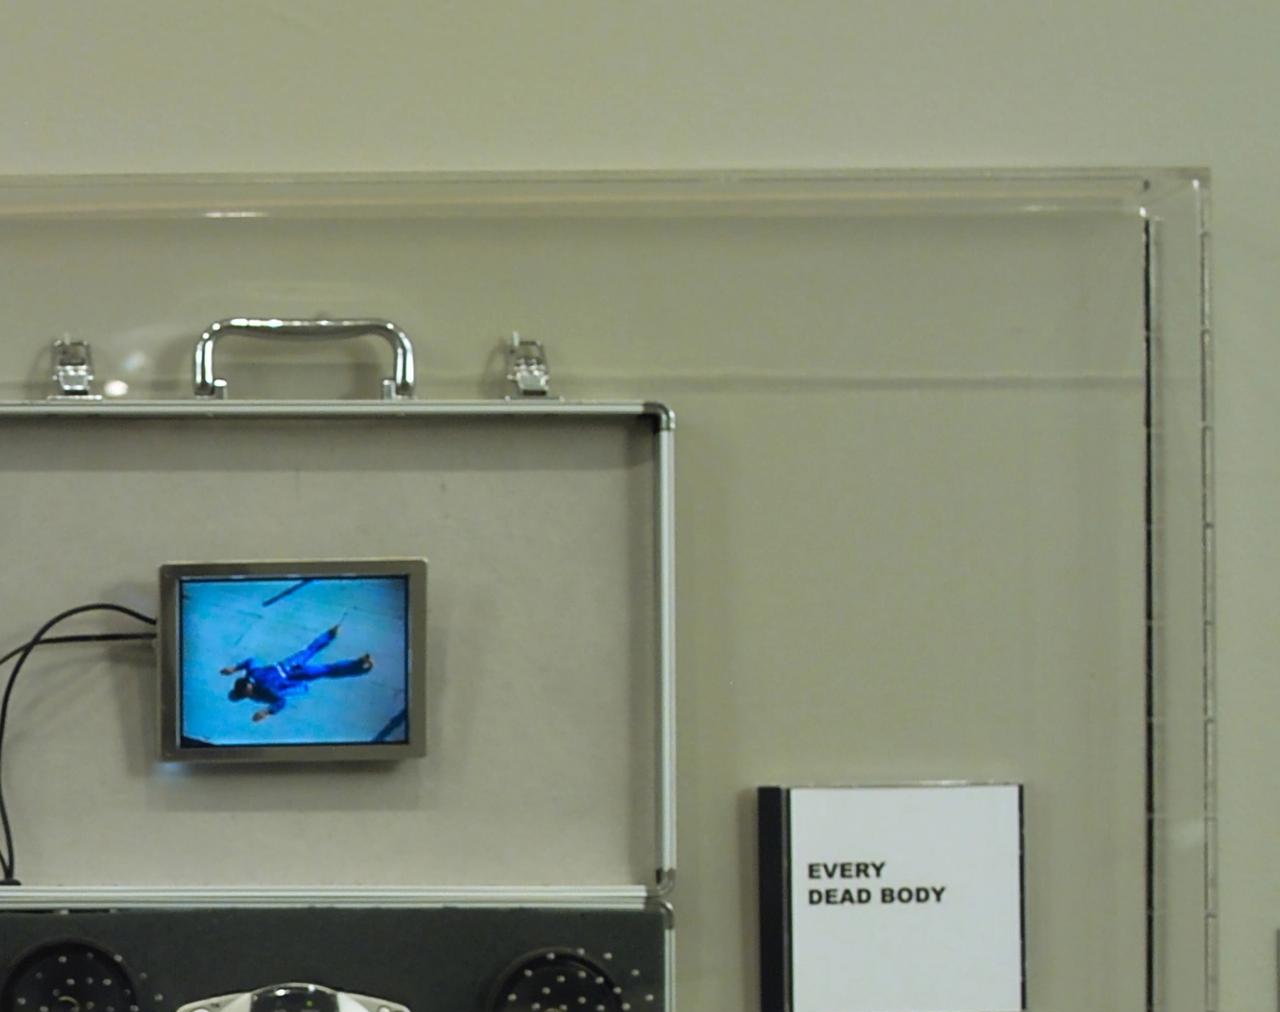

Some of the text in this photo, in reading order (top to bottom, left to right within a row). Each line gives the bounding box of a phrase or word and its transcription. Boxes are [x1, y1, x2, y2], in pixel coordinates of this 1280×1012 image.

[808, 862, 886, 879] EVERY
[808, 886, 946, 905] DEAD BODY
